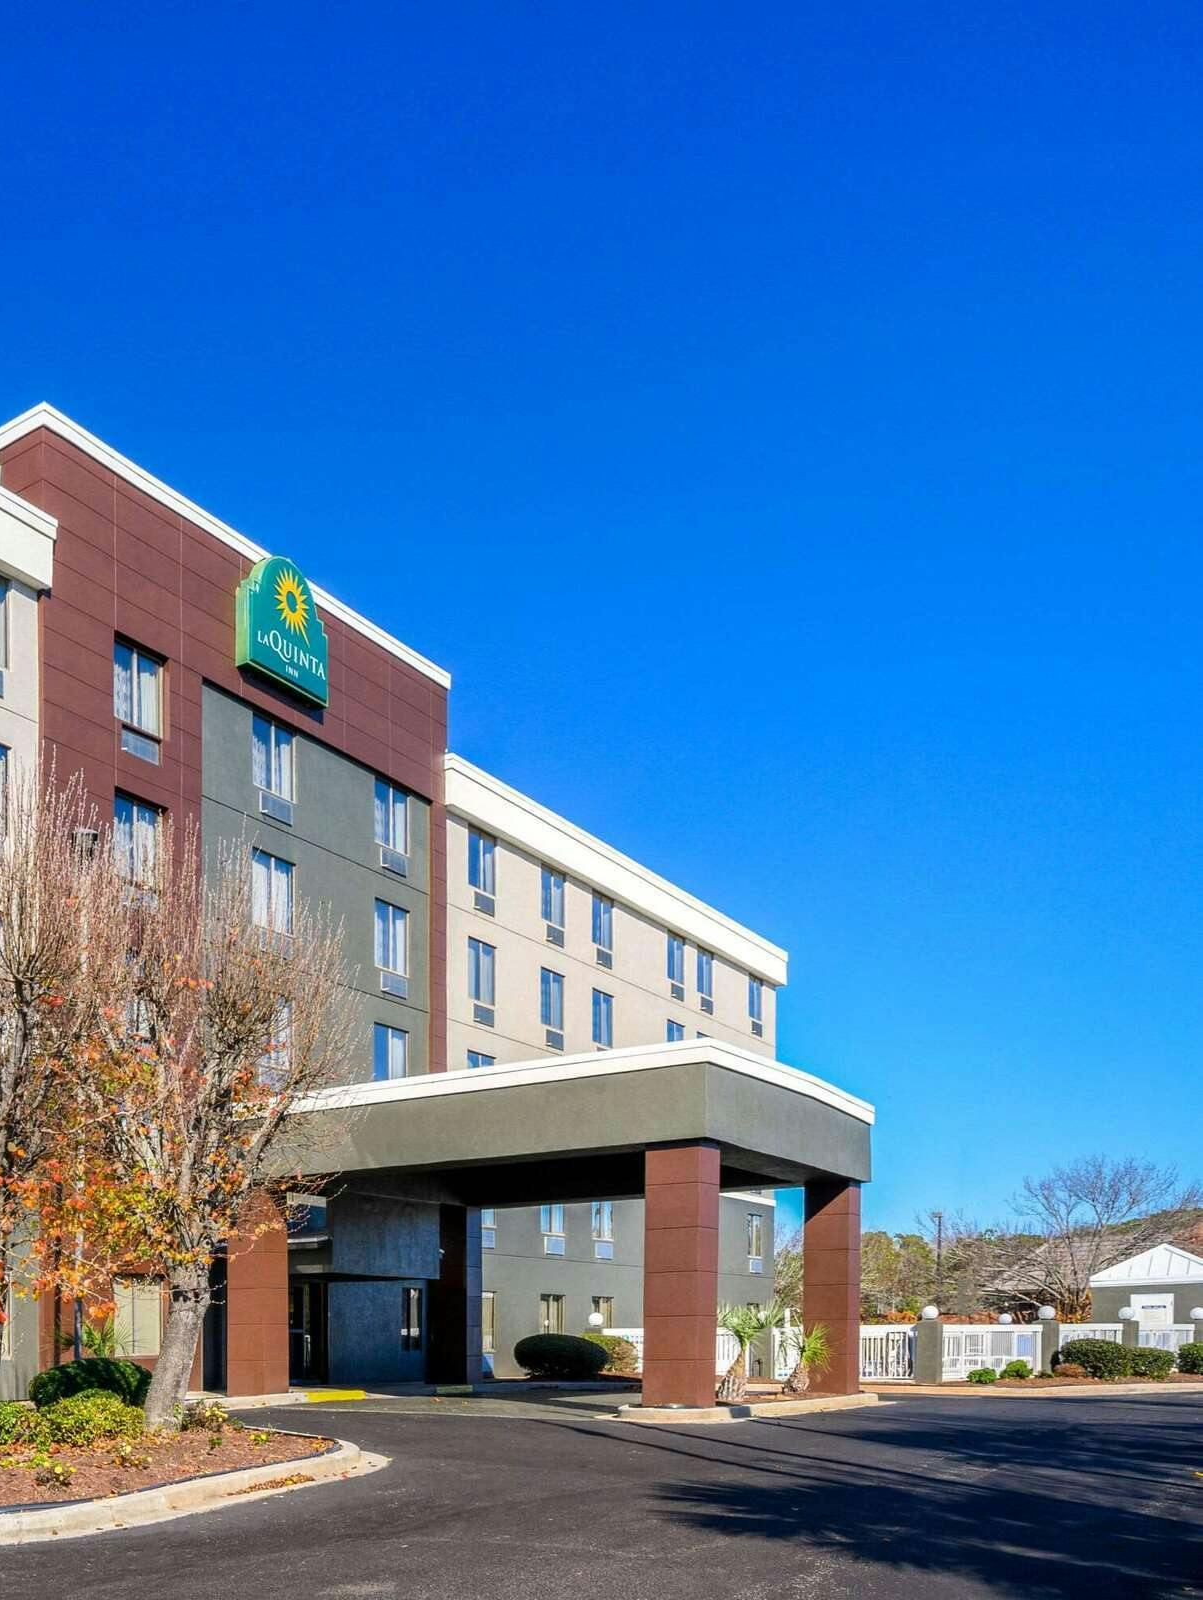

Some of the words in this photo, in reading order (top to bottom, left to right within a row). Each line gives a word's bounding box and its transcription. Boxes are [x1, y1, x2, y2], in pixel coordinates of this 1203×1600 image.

[257, 630, 270, 647] LA
[269, 630, 326, 680] QUINTA
[285, 664, 299, 678] INN
